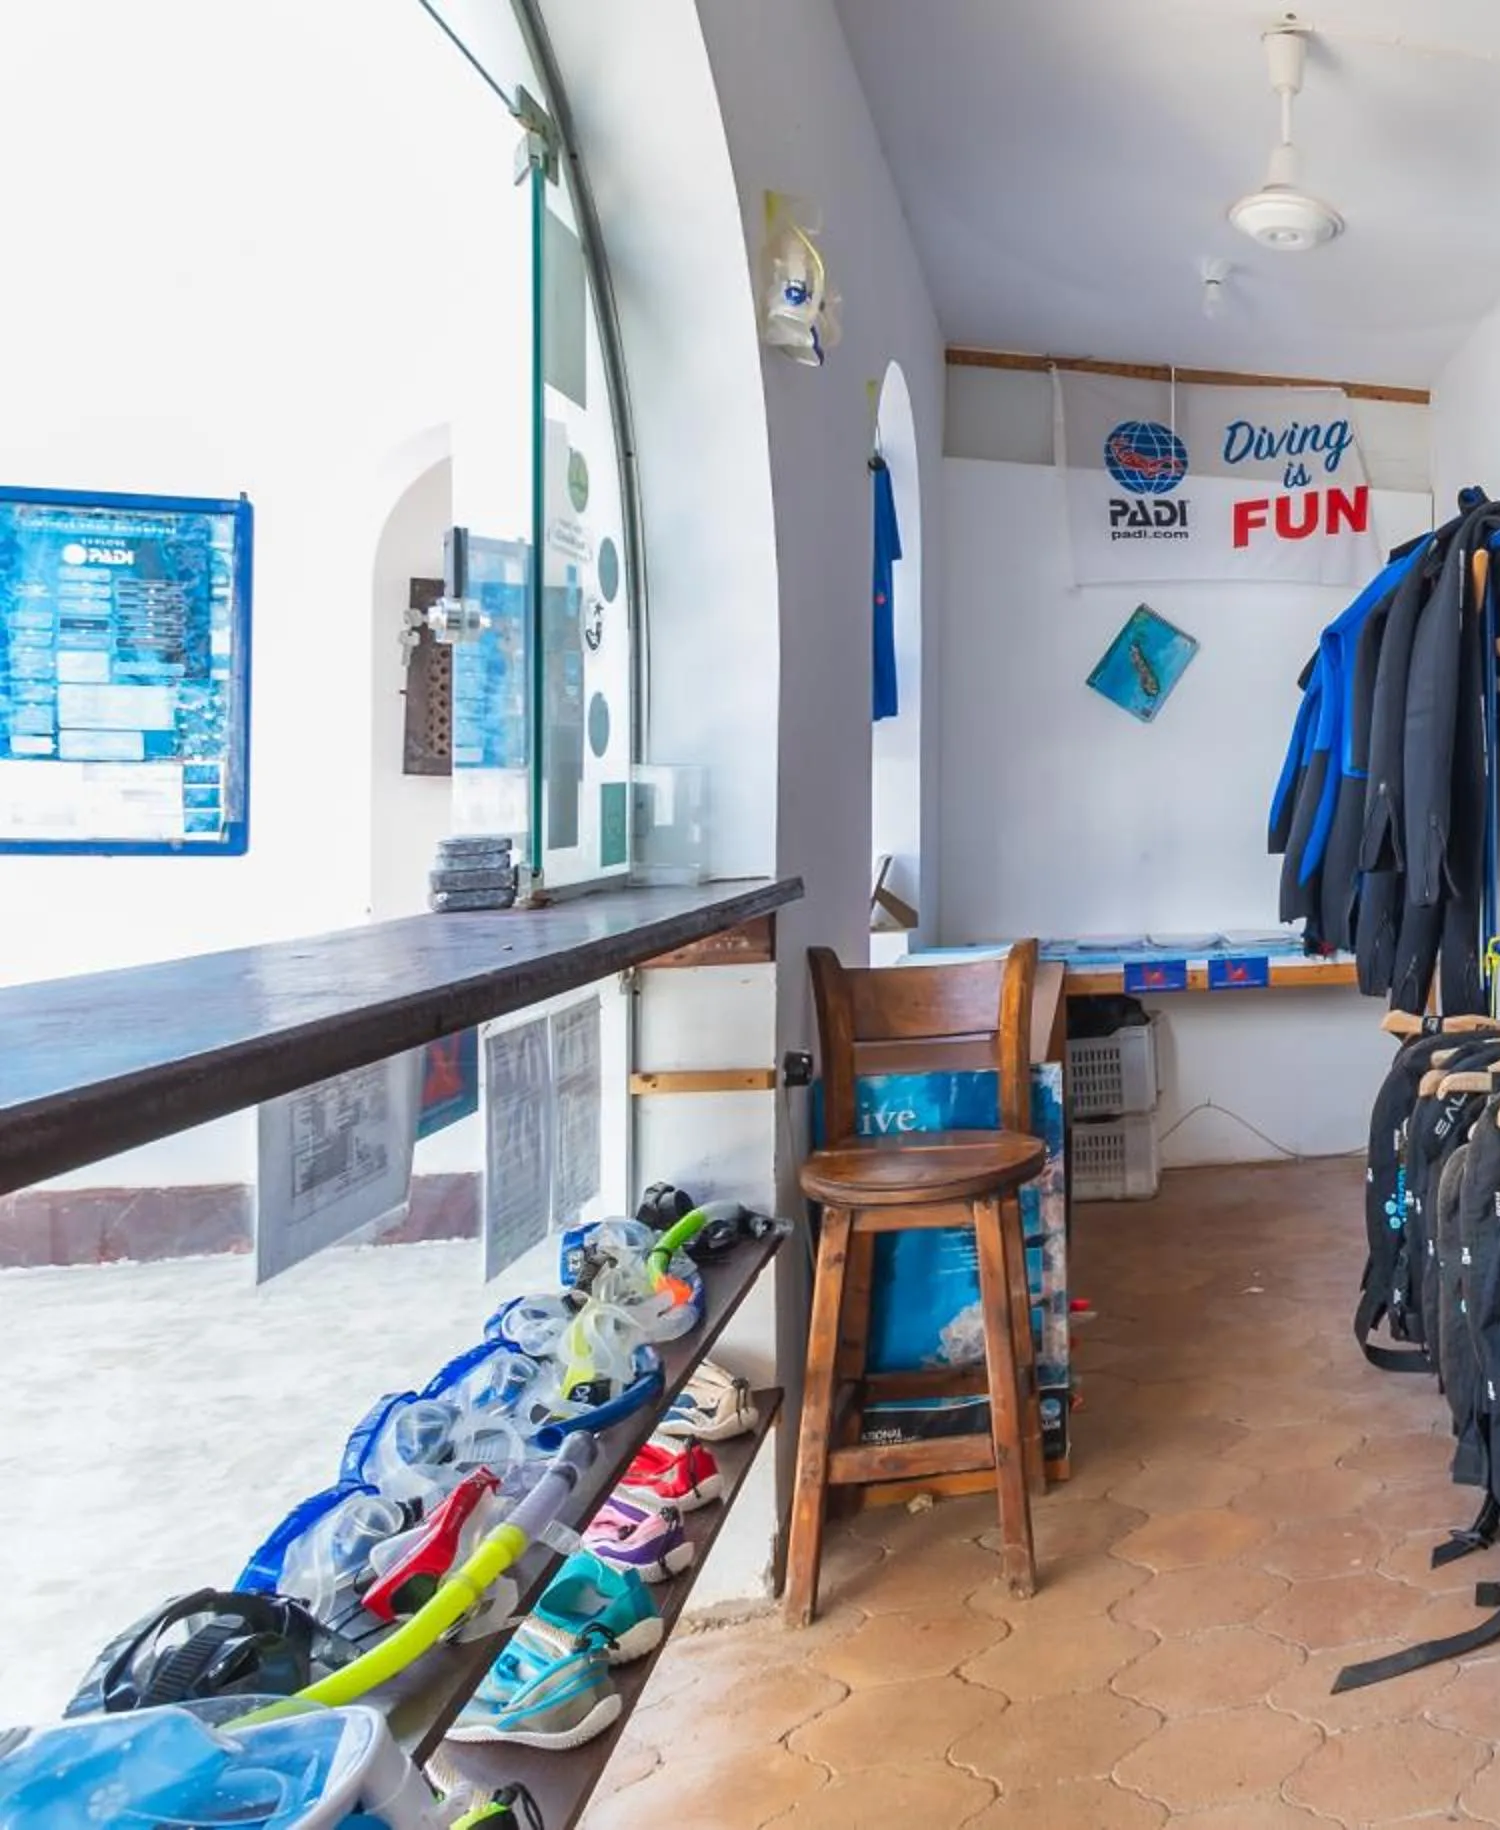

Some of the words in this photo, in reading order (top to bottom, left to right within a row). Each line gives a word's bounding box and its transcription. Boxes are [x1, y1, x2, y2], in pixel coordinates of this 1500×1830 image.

[1223, 418, 1354, 473] Diving
[1283, 461, 1312, 489] is
[1109, 499, 1188, 527] PADI
[1233, 486, 1369, 549] FUN
[1111, 530, 1189, 541] padi.com
[860, 1102, 928, 1136] ive.
